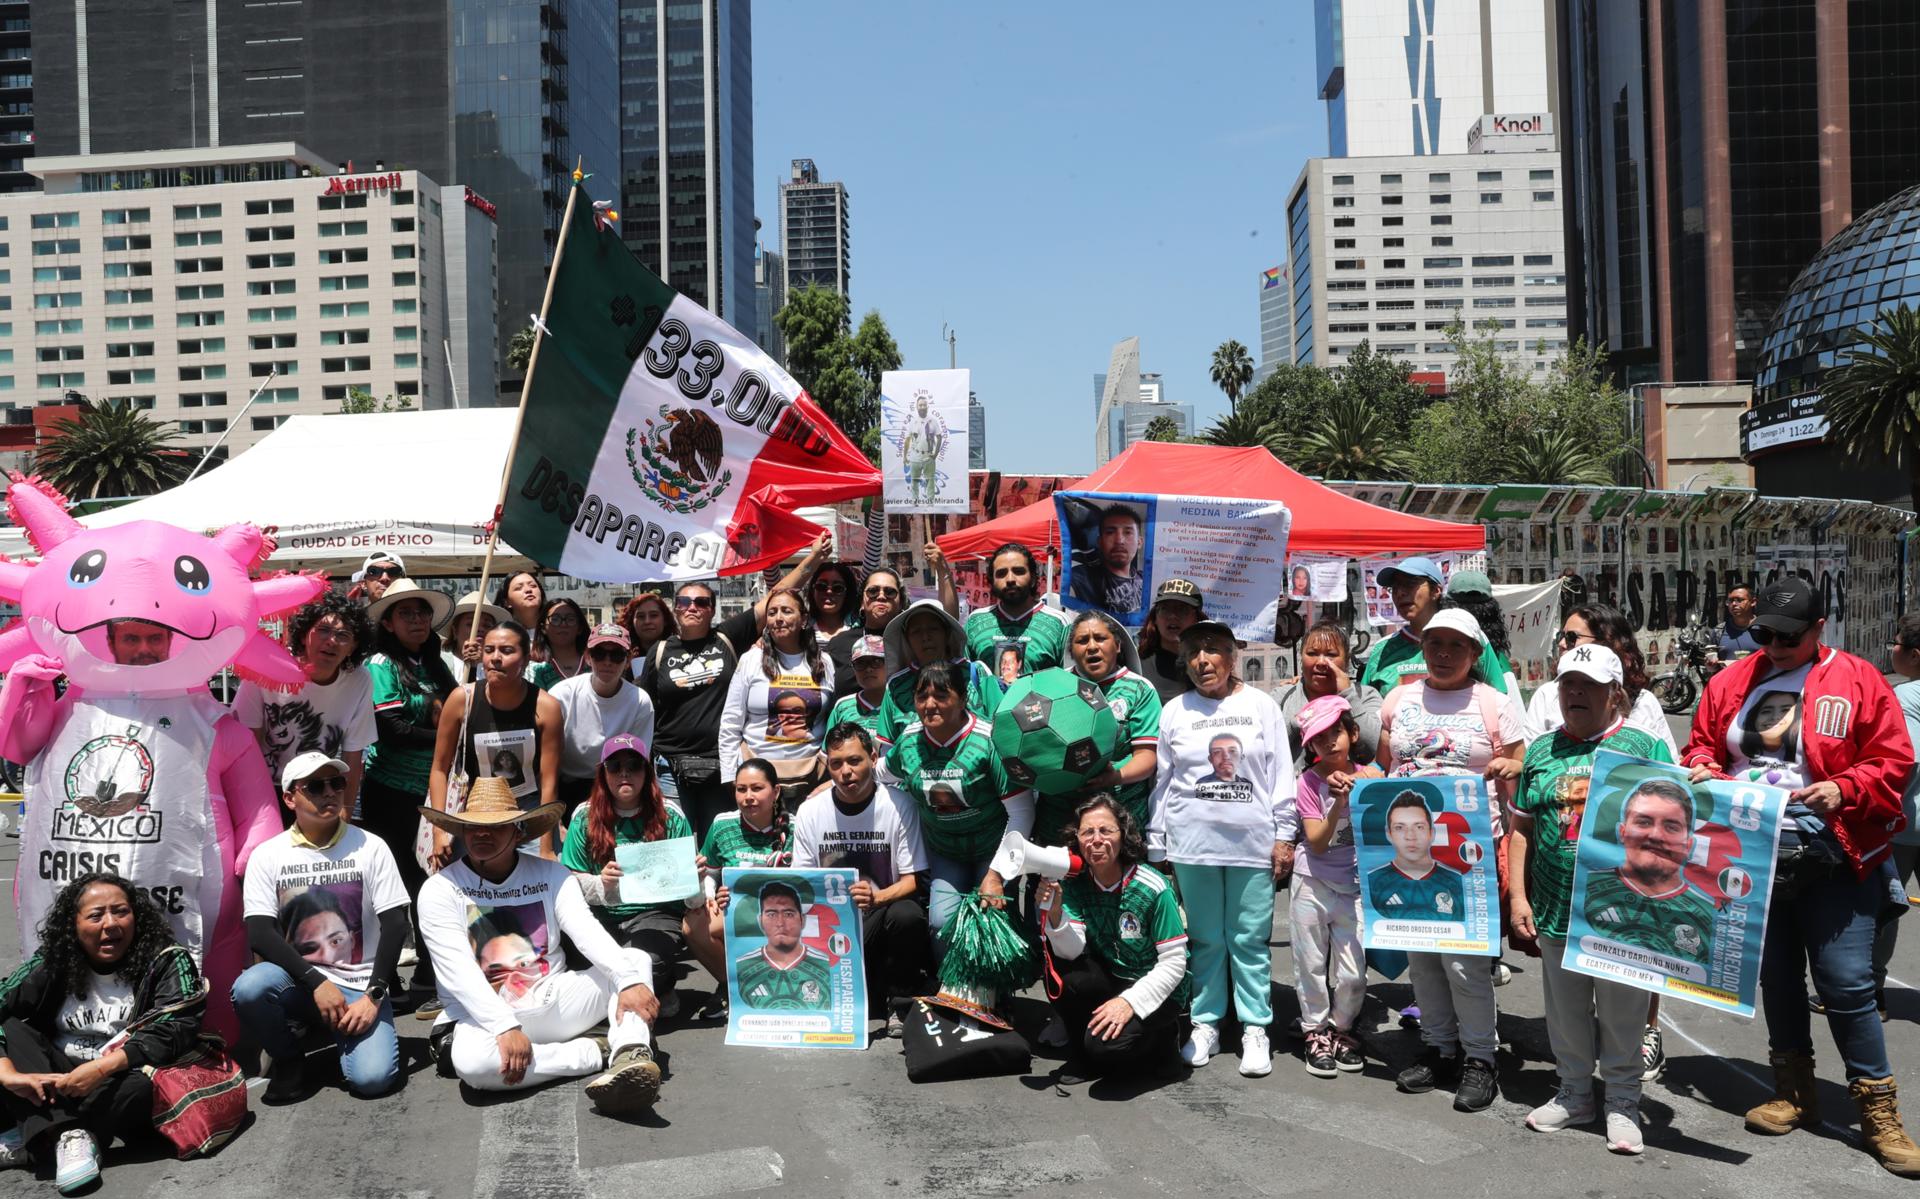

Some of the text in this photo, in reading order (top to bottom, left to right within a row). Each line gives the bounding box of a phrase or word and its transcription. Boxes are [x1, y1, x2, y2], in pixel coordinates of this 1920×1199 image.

[1494, 116, 1541, 132] Knoll
[324, 172, 401, 196] Marriott
[1789, 423, 1814, 438] 11:22
[1181, 507, 1220, 517] MEDINA
[291, 531, 433, 548] CIUDAD DE MÉXICO
[849, 831, 885, 840] GERARDO
[39, 850, 121, 881] CRISIS
[312, 859, 356, 873] GERARDO
[1473, 866, 1488, 940] DESAPARECIDO
[1386, 924, 1410, 933] RICARDO
[1411, 925, 1432, 934] OROZCO
[1593, 942, 1626, 958] GONZALO
[1721, 902, 1748, 993] DESAPARECIDO
[1623, 968, 1637, 978] EDO
[840, 958, 854, 1033] DESAPARECIDO
